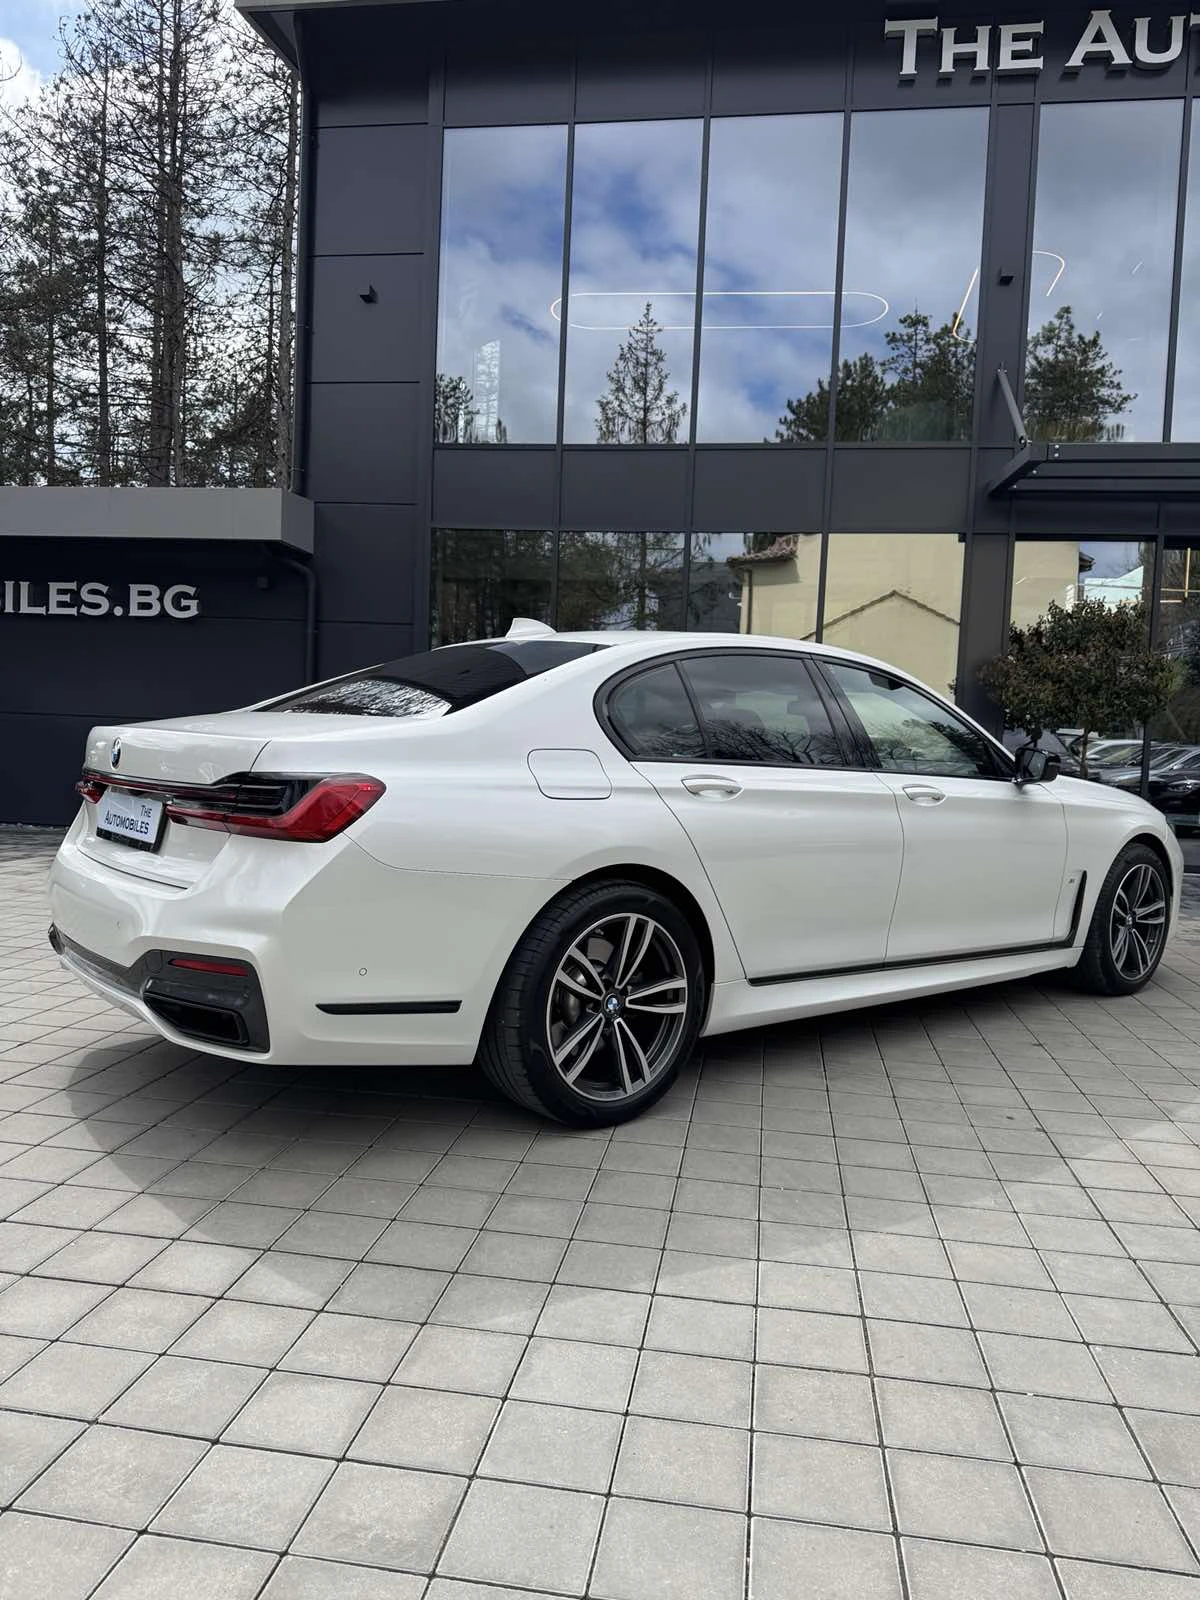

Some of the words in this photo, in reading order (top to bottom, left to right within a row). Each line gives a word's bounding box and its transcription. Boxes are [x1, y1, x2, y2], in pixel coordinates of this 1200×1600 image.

[884, 16, 1044, 75] THE
[0, 580, 199, 619] ILES.BG
[104, 809, 150, 835] AUTOMOBILES
[140, 804, 153, 818] THE
